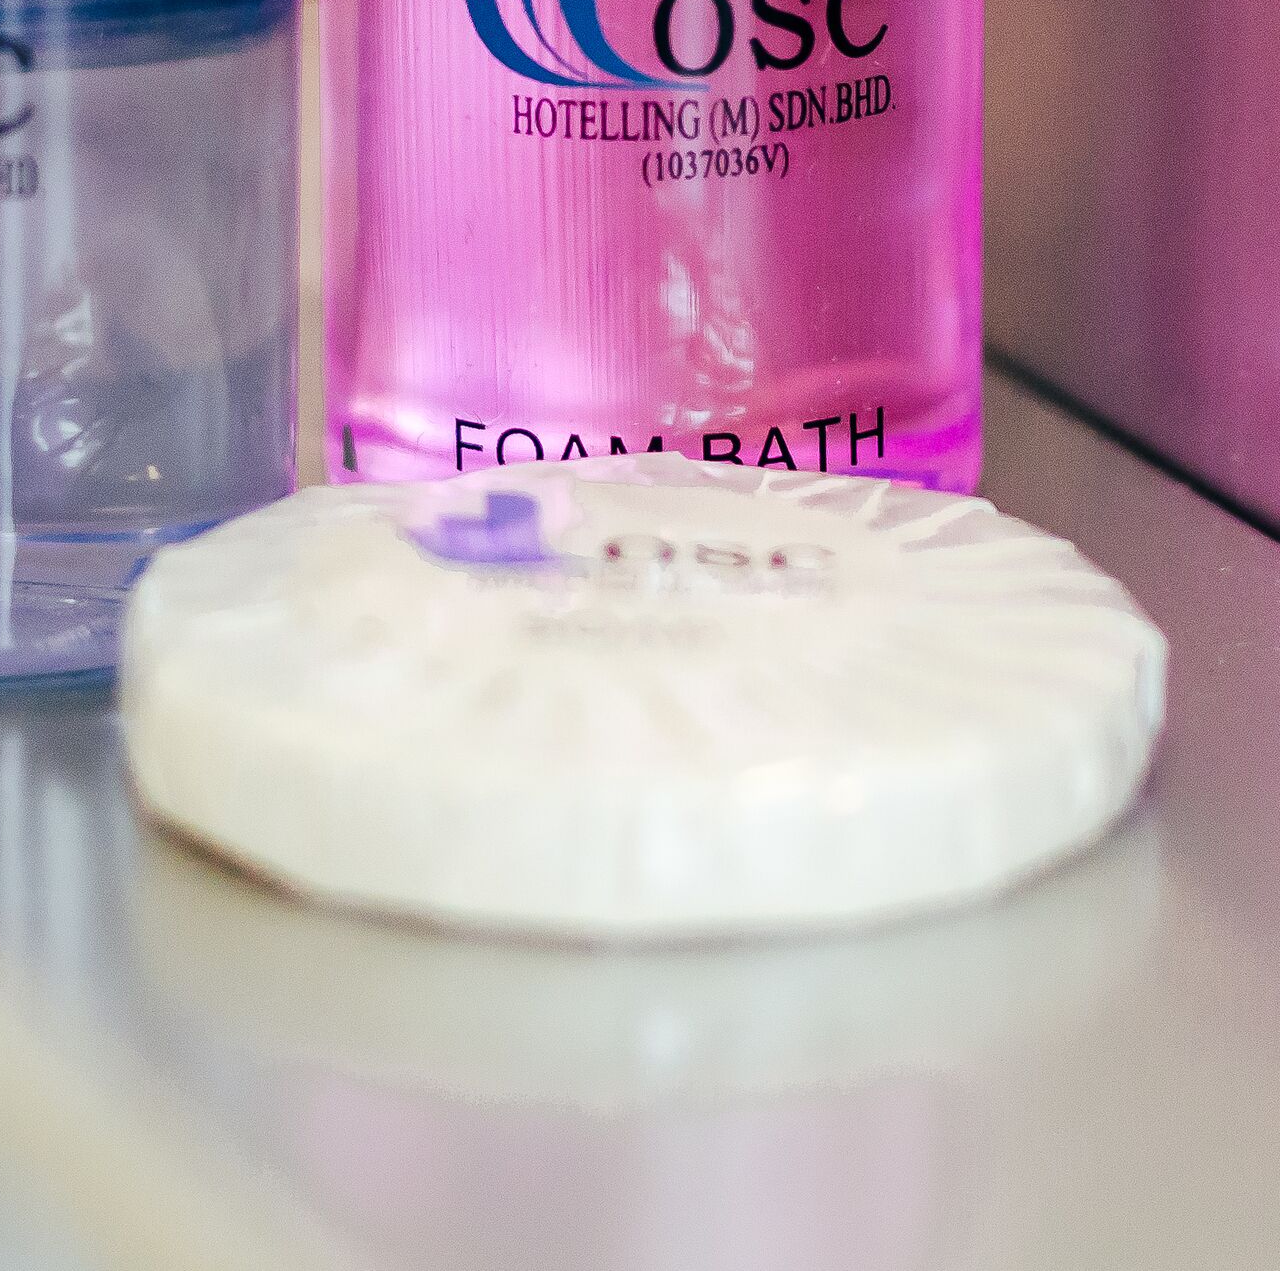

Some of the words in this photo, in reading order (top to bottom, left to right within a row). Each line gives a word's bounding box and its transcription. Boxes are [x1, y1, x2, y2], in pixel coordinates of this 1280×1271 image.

[511, 94, 700, 142] HOTELLING
[708, 95, 761, 145] (M)
[766, 73, 897, 132] SDN.BHD.
[641, 141, 790, 189] (1037036V)
[701, 405, 885, 473] BATH
